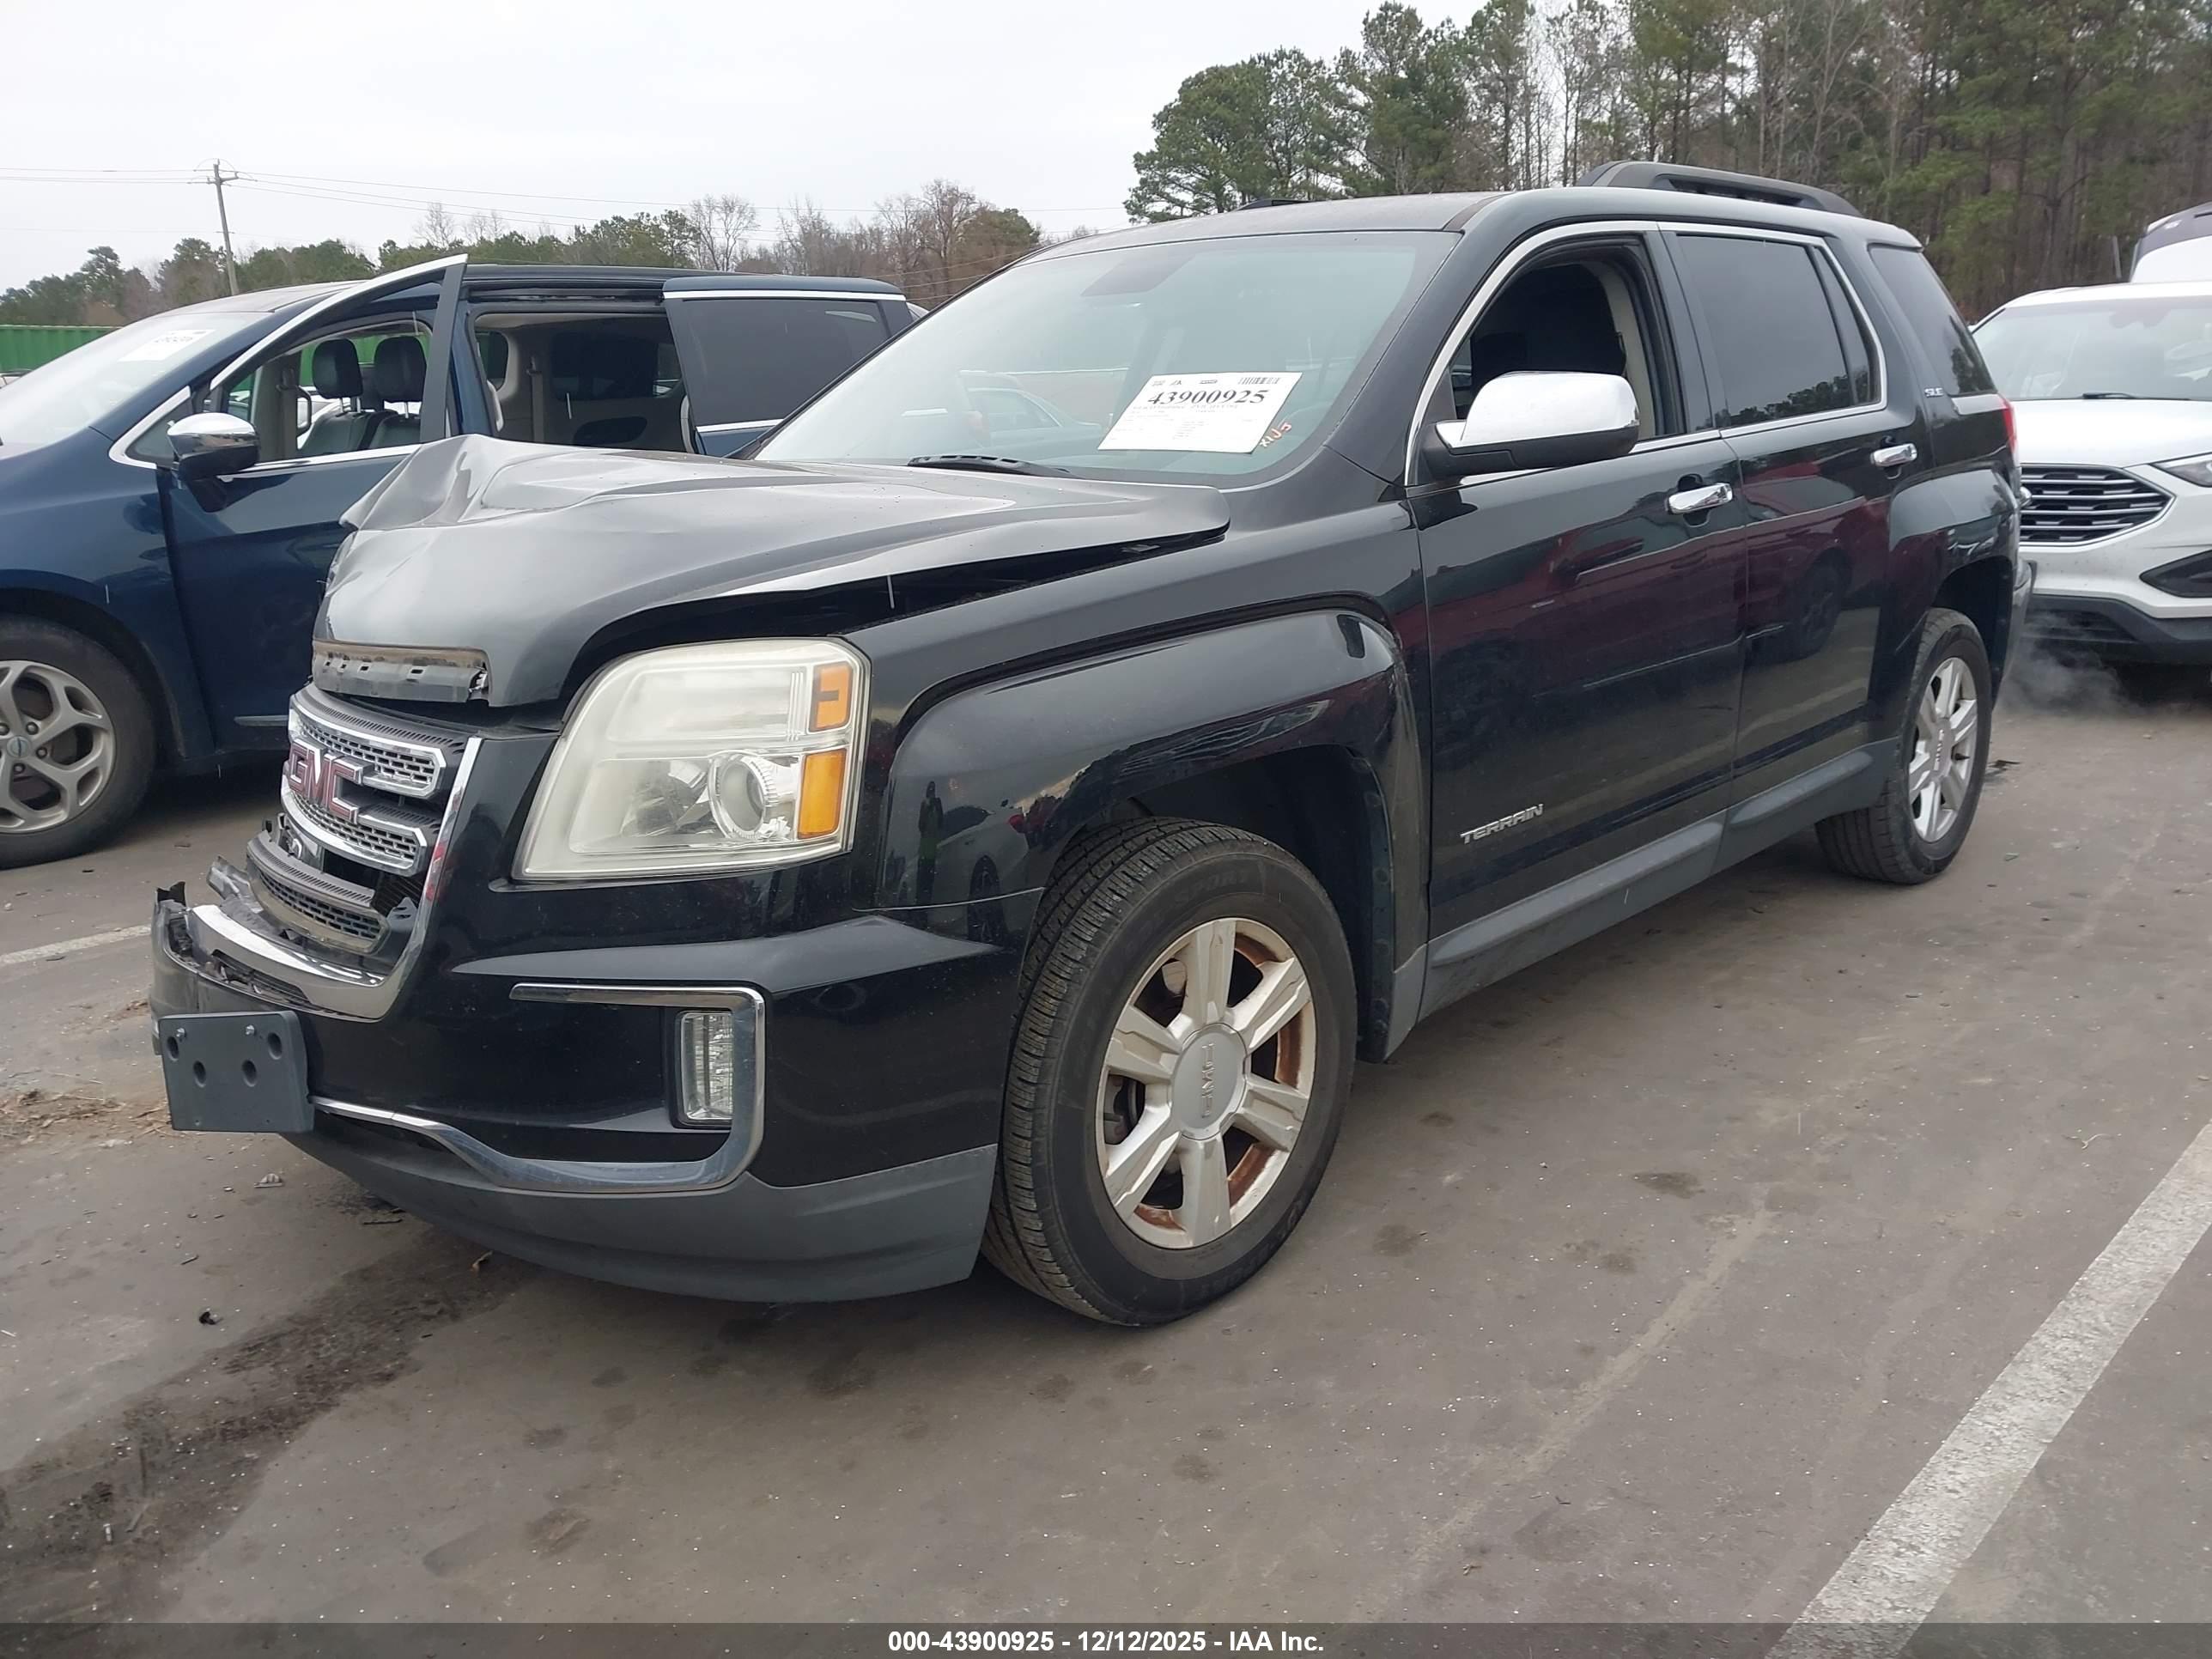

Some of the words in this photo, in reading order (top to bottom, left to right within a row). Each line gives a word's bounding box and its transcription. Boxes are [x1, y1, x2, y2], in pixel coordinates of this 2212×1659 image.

[1147, 390, 1268, 404] 43900925
[289, 738, 363, 824] GMC
[1460, 803, 1544, 844] TERRAIN
